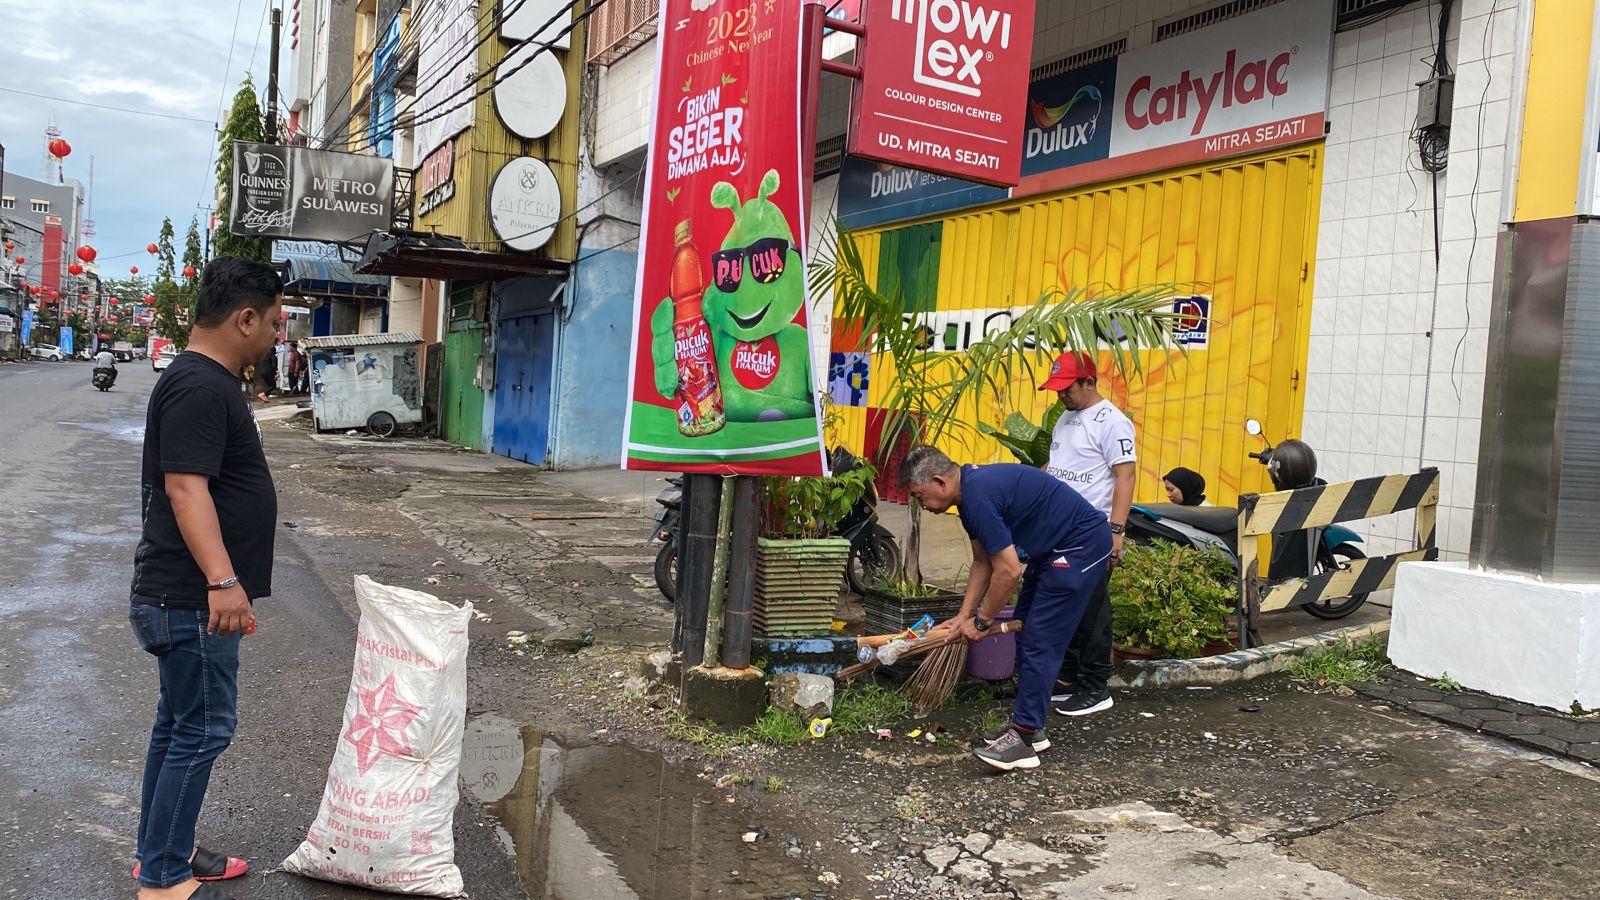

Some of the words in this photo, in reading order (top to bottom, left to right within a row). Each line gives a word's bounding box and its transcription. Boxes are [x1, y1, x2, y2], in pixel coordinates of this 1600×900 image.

[707, 2, 758, 45] 2023
[686, 43, 724, 67] Chinese
[1124, 49, 1290, 136] Catylac
[885, 87, 926, 106] COLOUR
[928, 97, 964, 114] DESIGN
[966, 106, 1002, 124] CENTER
[668, 107, 744, 163] SEGER
[1026, 122, 1089, 159] Dulux
[1205, 133, 1251, 154] MITRA
[1255, 119, 1306, 142] SEJATI
[711, 146, 740, 166] AJA
[878, 132, 903, 150] UD.
[907, 139, 952, 160] MITRA
[955, 148, 1000, 170] SEJATI
[240, 173, 291, 190] GUINNESS
[313, 177, 376, 196] METRO
[870, 168, 914, 198] Dulux
[302, 197, 384, 216] SULAWESI
[275, 241, 312, 254] ENAM
[680, 345, 708, 360] HARUM
[740, 362, 772, 374] HARUM
[370, 786, 433, 809] ABADI
[327, 817, 351, 833] BERAT
[353, 828, 391, 840] BERSIH
[334, 837, 350, 848] 50
[353, 842, 370, 856] Kg
